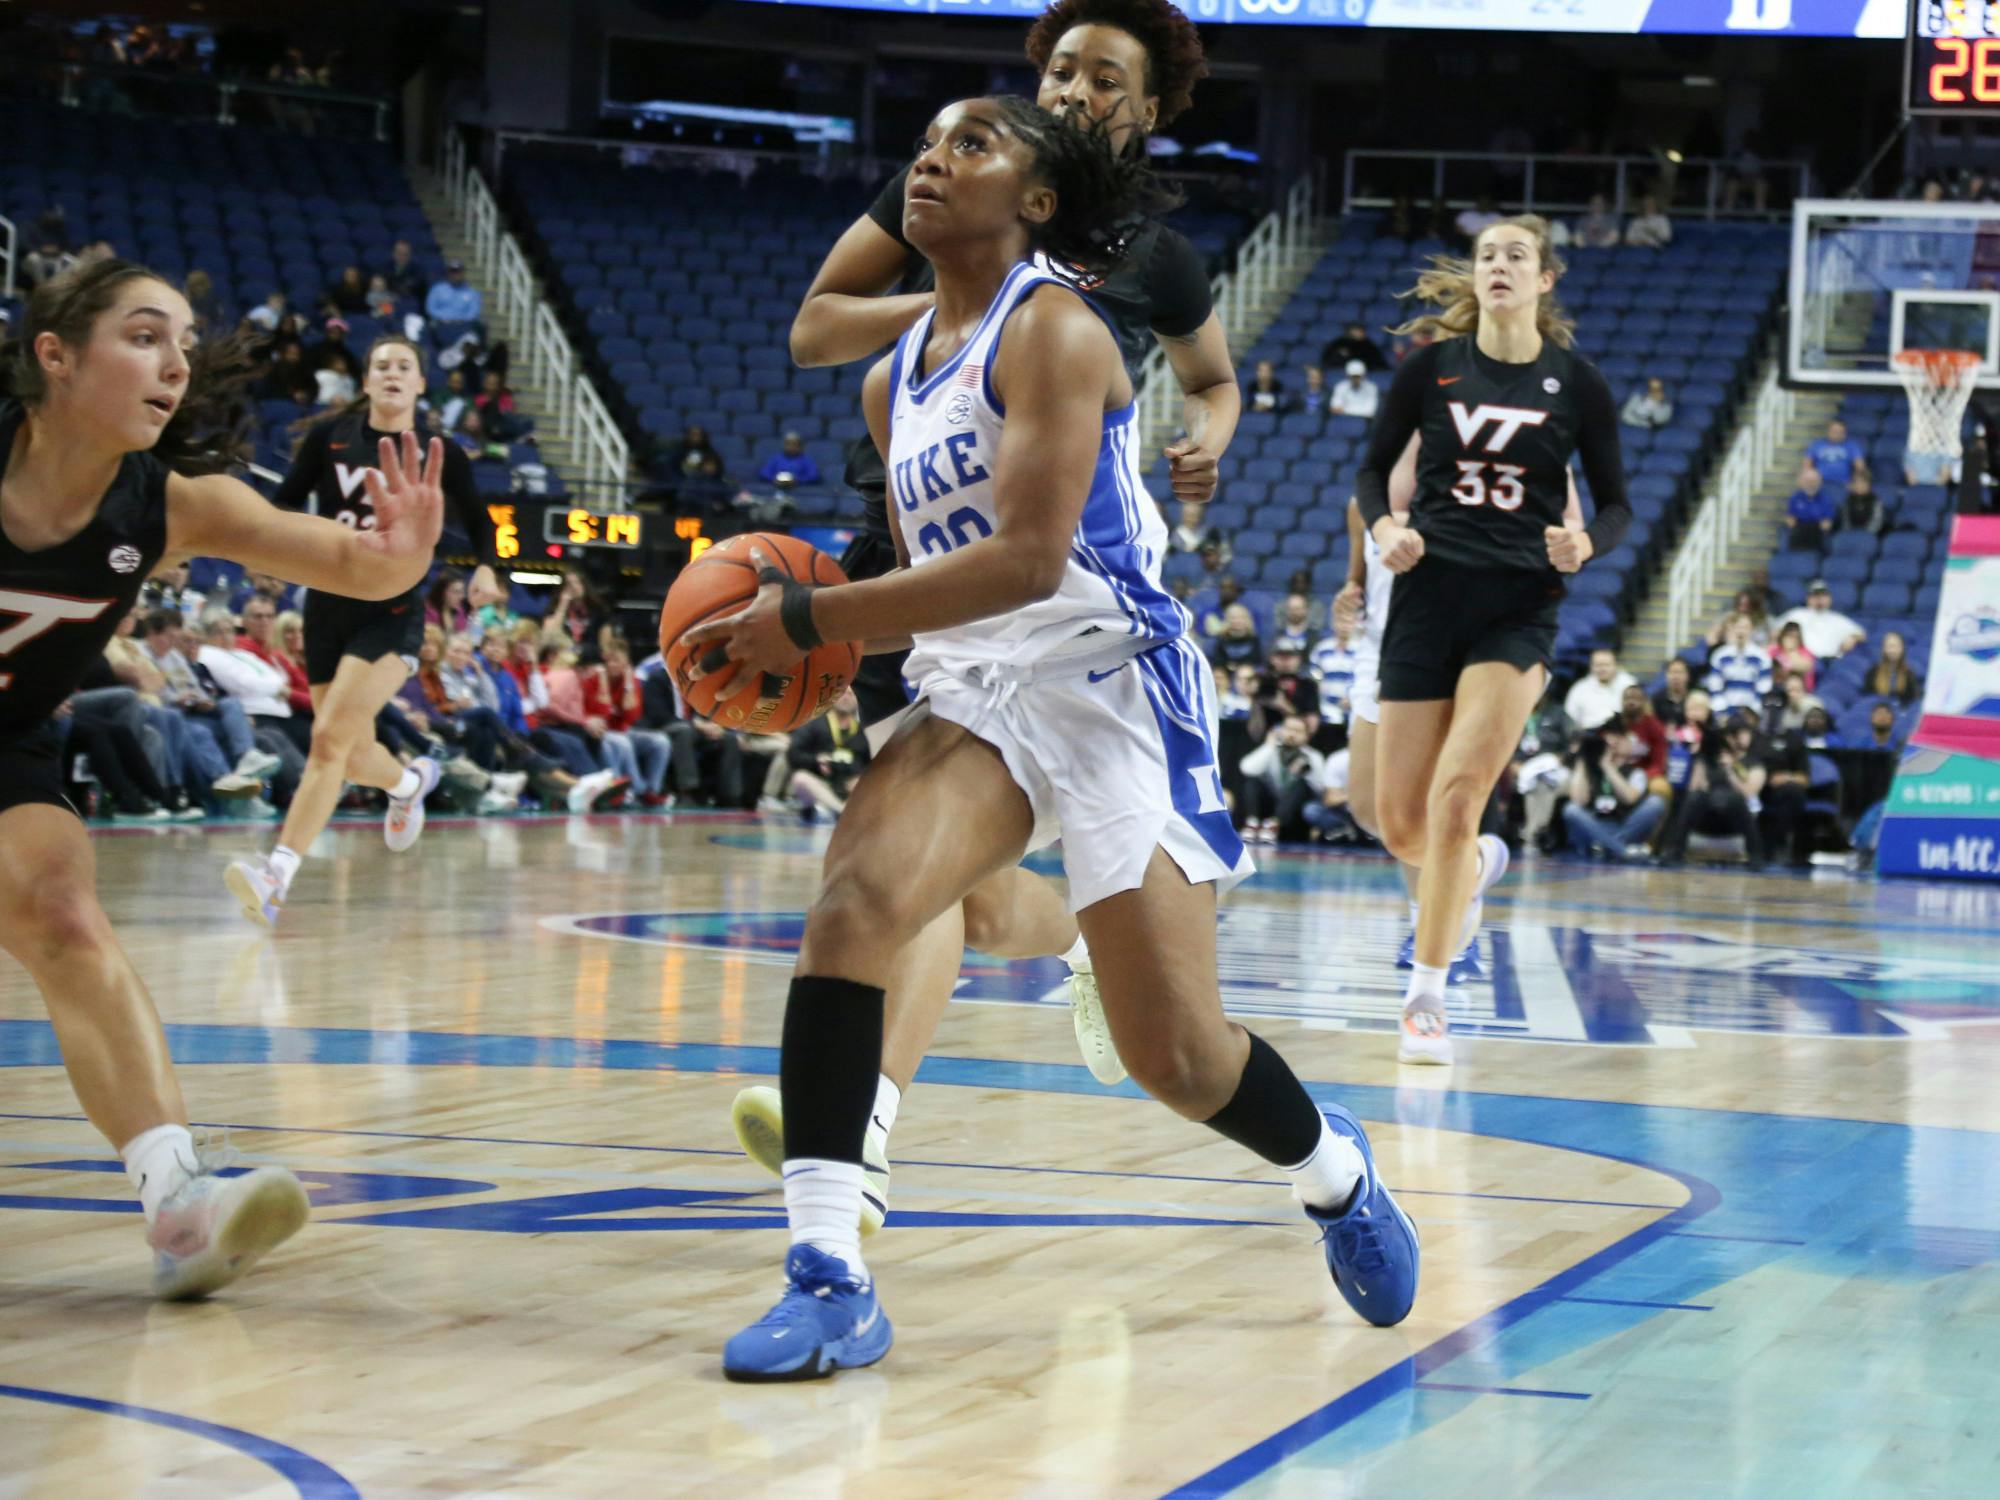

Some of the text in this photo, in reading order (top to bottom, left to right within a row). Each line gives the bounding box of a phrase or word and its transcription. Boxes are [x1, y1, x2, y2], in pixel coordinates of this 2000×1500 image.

[1928, 37, 2000, 102] 26
[1447, 401, 1551, 453] VT
[895, 431, 990, 513] UKE
[1451, 460, 1528, 512] 33
[0, 586, 117, 658] T
